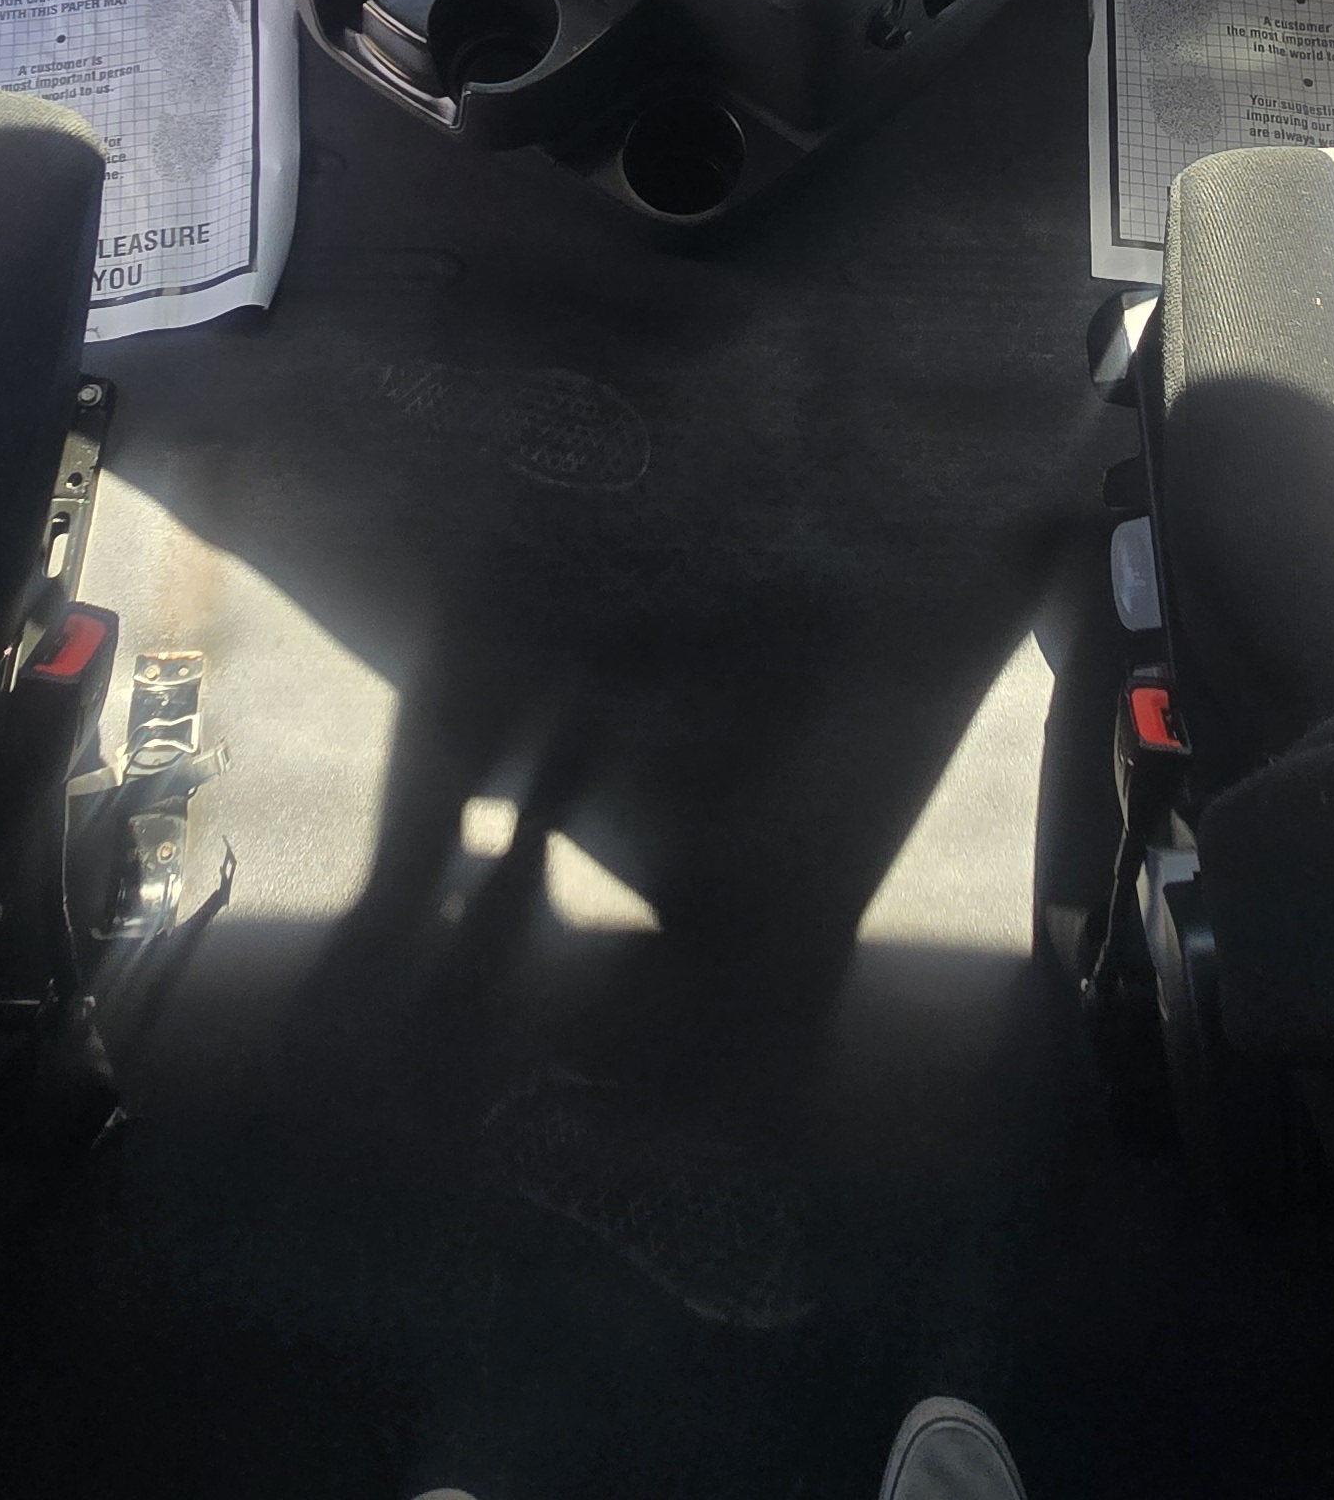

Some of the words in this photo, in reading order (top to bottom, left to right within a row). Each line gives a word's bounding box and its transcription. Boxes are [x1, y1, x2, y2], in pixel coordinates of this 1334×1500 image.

[31, 4, 58, 17] THIS
[61, 0, 100, 13] PAPER
[1227, 25, 1246, 37] the
[1250, 29, 1279, 42] most
[1263, 16, 1272, 27] A
[1275, 19, 1332, 33] customer
[1253, 42, 1265, 53] in
[1268, 44, 1286, 57] the
[1290, 48, 1323, 61] world
[17, 65, 27, 76] A
[31, 58, 89, 74] customer
[92, 55, 103, 66] is
[1, 79, 32, 92] most
[36, 70, 96, 89] important
[99, 64, 141, 81] person
[41, 88, 76, 101] world
[80, 86, 92, 96] to
[1249, 95, 1277, 108] Your
[1246, 109, 1308, 130] improving
[1311, 121, 1331, 132] our
[1249, 127, 1270, 137] are
[1274, 129, 1316, 146] always
[98, 223, 211, 259] LEASURE
[93, 264, 143, 291] YOU
